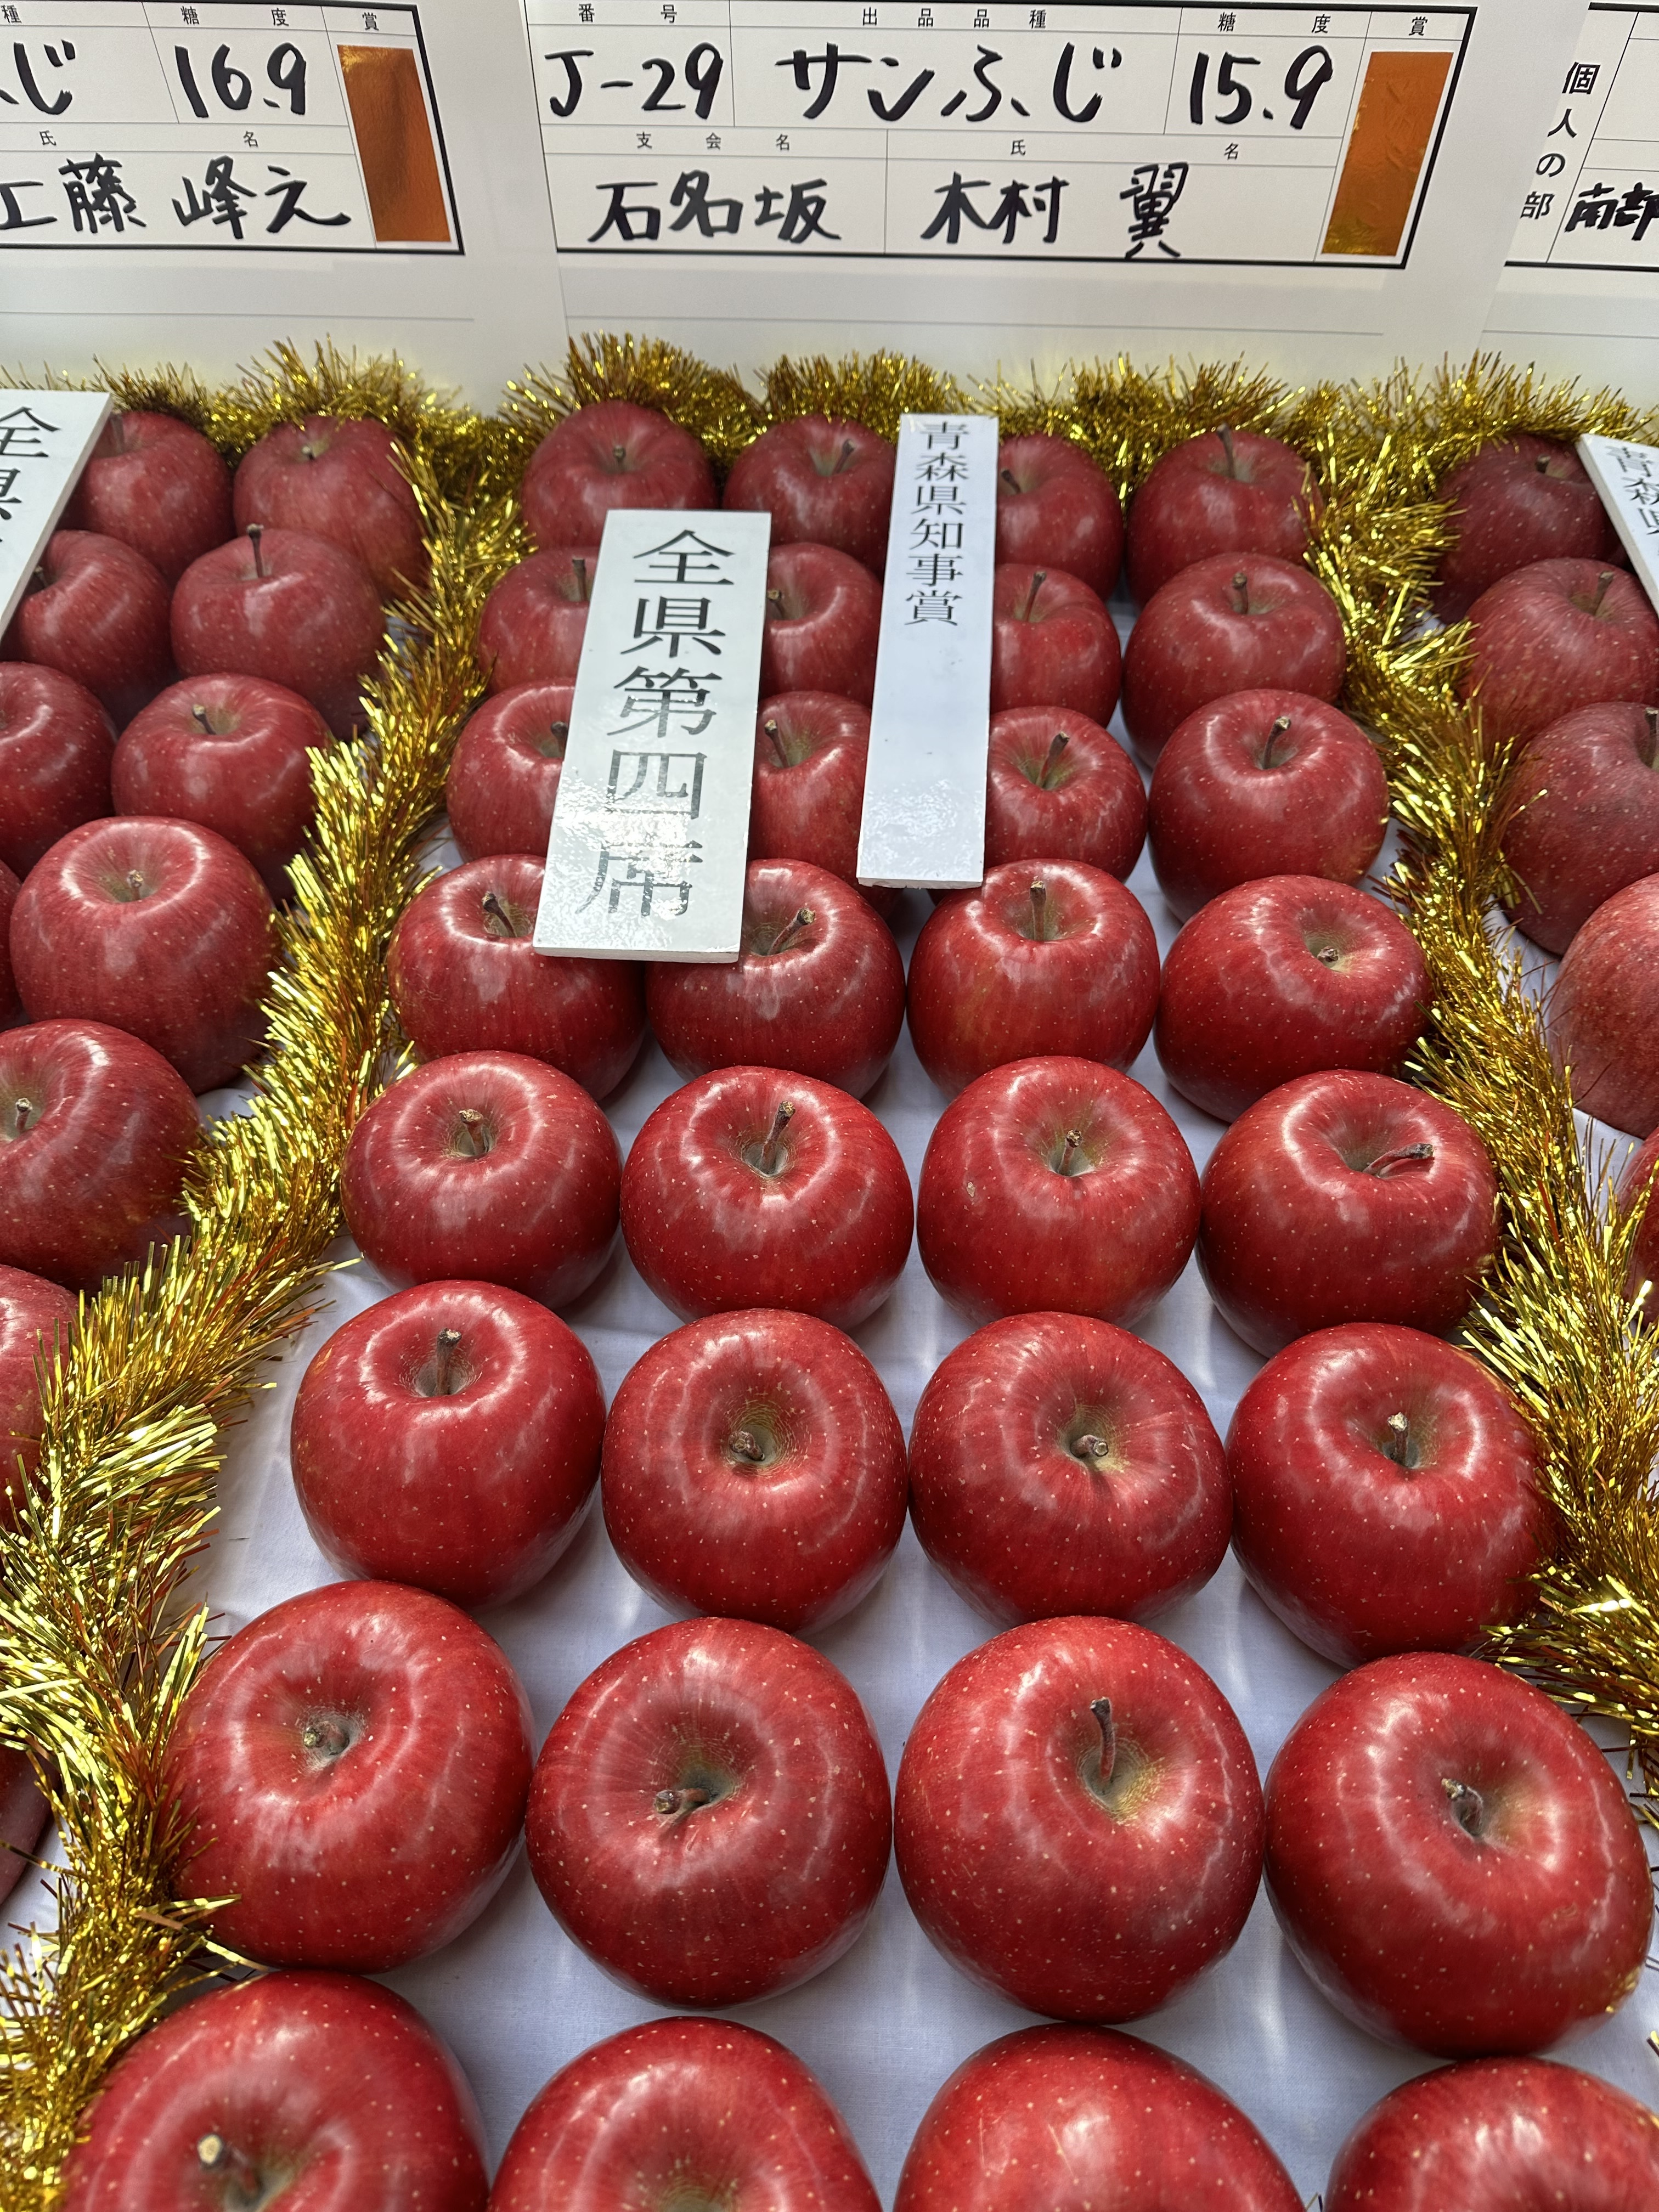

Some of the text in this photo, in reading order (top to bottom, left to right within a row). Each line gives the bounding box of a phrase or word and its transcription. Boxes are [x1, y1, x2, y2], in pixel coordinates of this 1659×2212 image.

[2, 5, 380, 31] 種 糖度 賞
[578, 3, 1428, 36] 番号 出品品種 糖度 賞
[0, 40, 75, 115] じ
[545, 42, 1333, 130] J-29 サンふじ 15.9
[636, 132, 791, 151] 支会名
[1520, 61, 1601, 220] 個人の部
[0, 153, 146, 234] 工藤
[588, 162, 1189, 260] 石名坂 木村 翼
[903, 420, 970, 627] 青森県知事賞
[574, 528, 736, 918] 全県第四席
